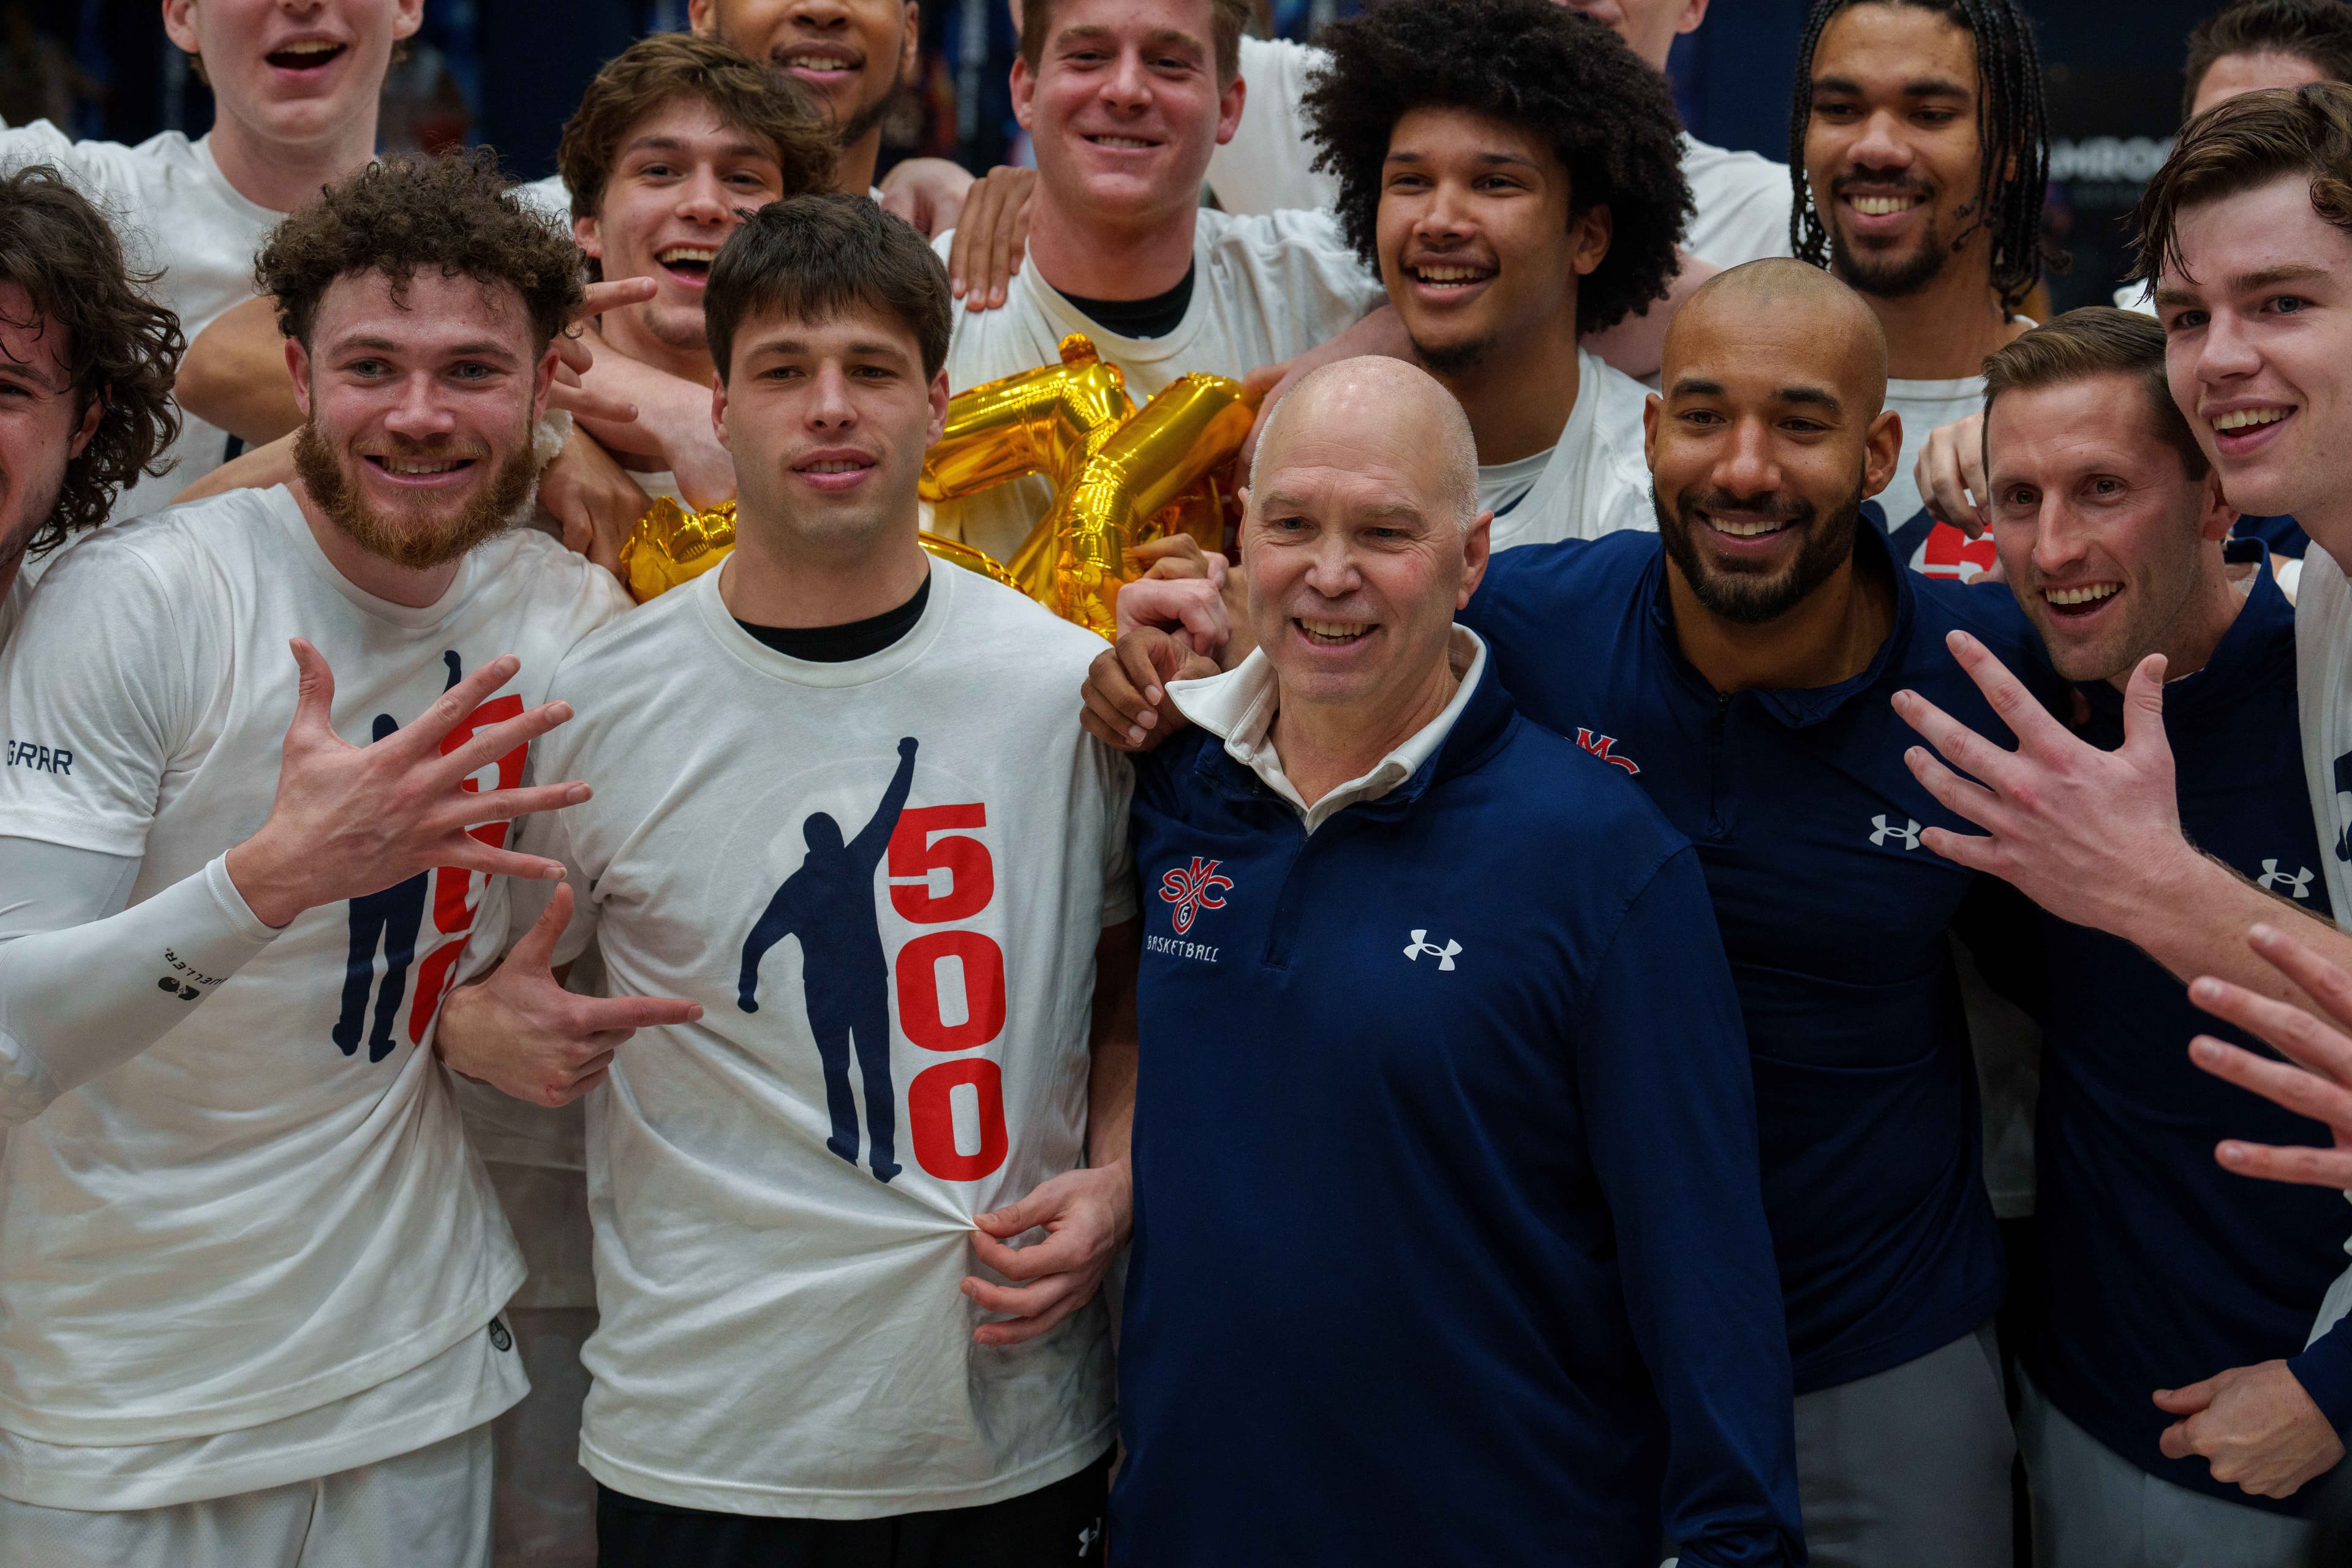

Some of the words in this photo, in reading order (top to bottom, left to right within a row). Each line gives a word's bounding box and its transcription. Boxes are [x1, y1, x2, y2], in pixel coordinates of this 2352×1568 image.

[7, 740, 73, 775] GRRR
[1146, 935, 1219, 963] BASKETBALL
[888, 802, 1009, 1182] 500
